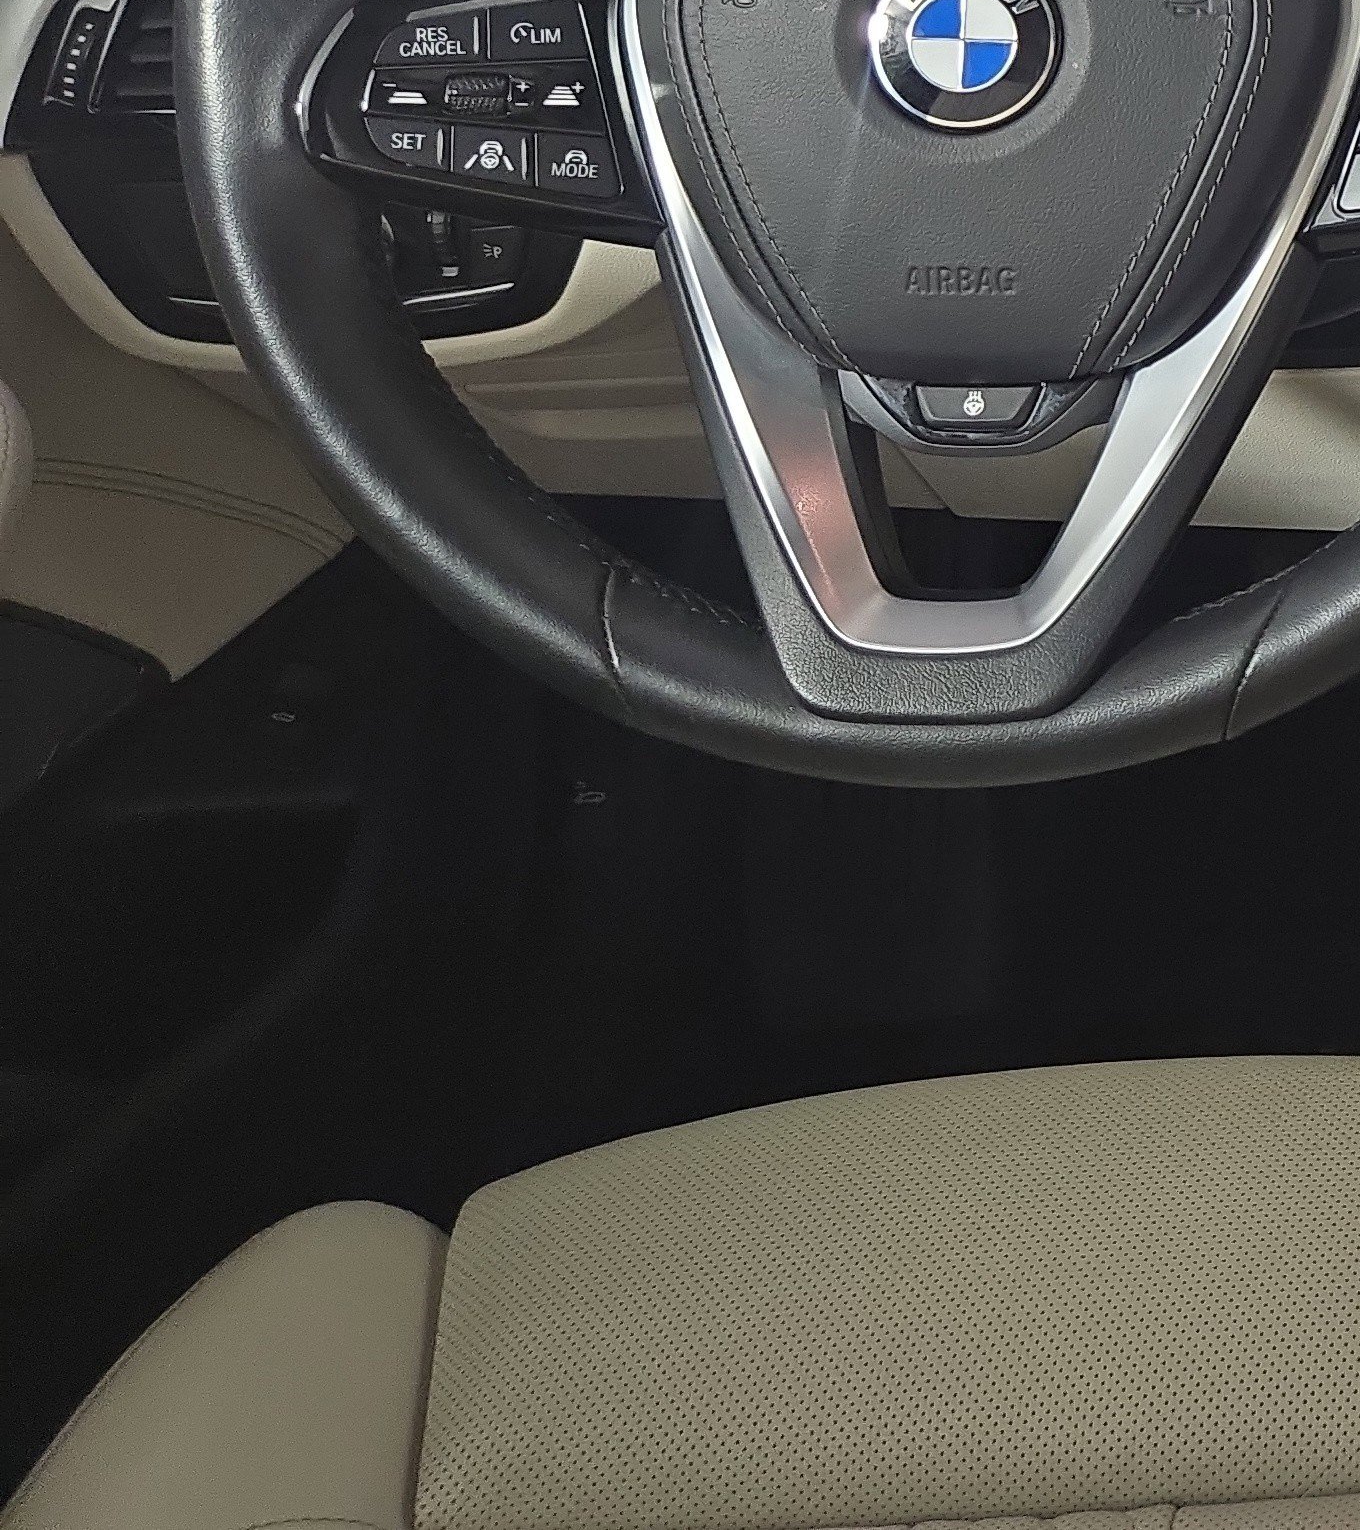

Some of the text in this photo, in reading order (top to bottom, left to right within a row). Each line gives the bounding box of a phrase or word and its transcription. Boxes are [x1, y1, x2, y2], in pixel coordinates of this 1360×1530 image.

[415, 27, 449, 43] RES
[530, 27, 562, 44] LIM
[399, 40, 467, 57] CANCEL
[390, 132, 426, 151] SET
[551, 162, 599, 179] MODE
[905, 265, 1018, 297] AIRBAG
